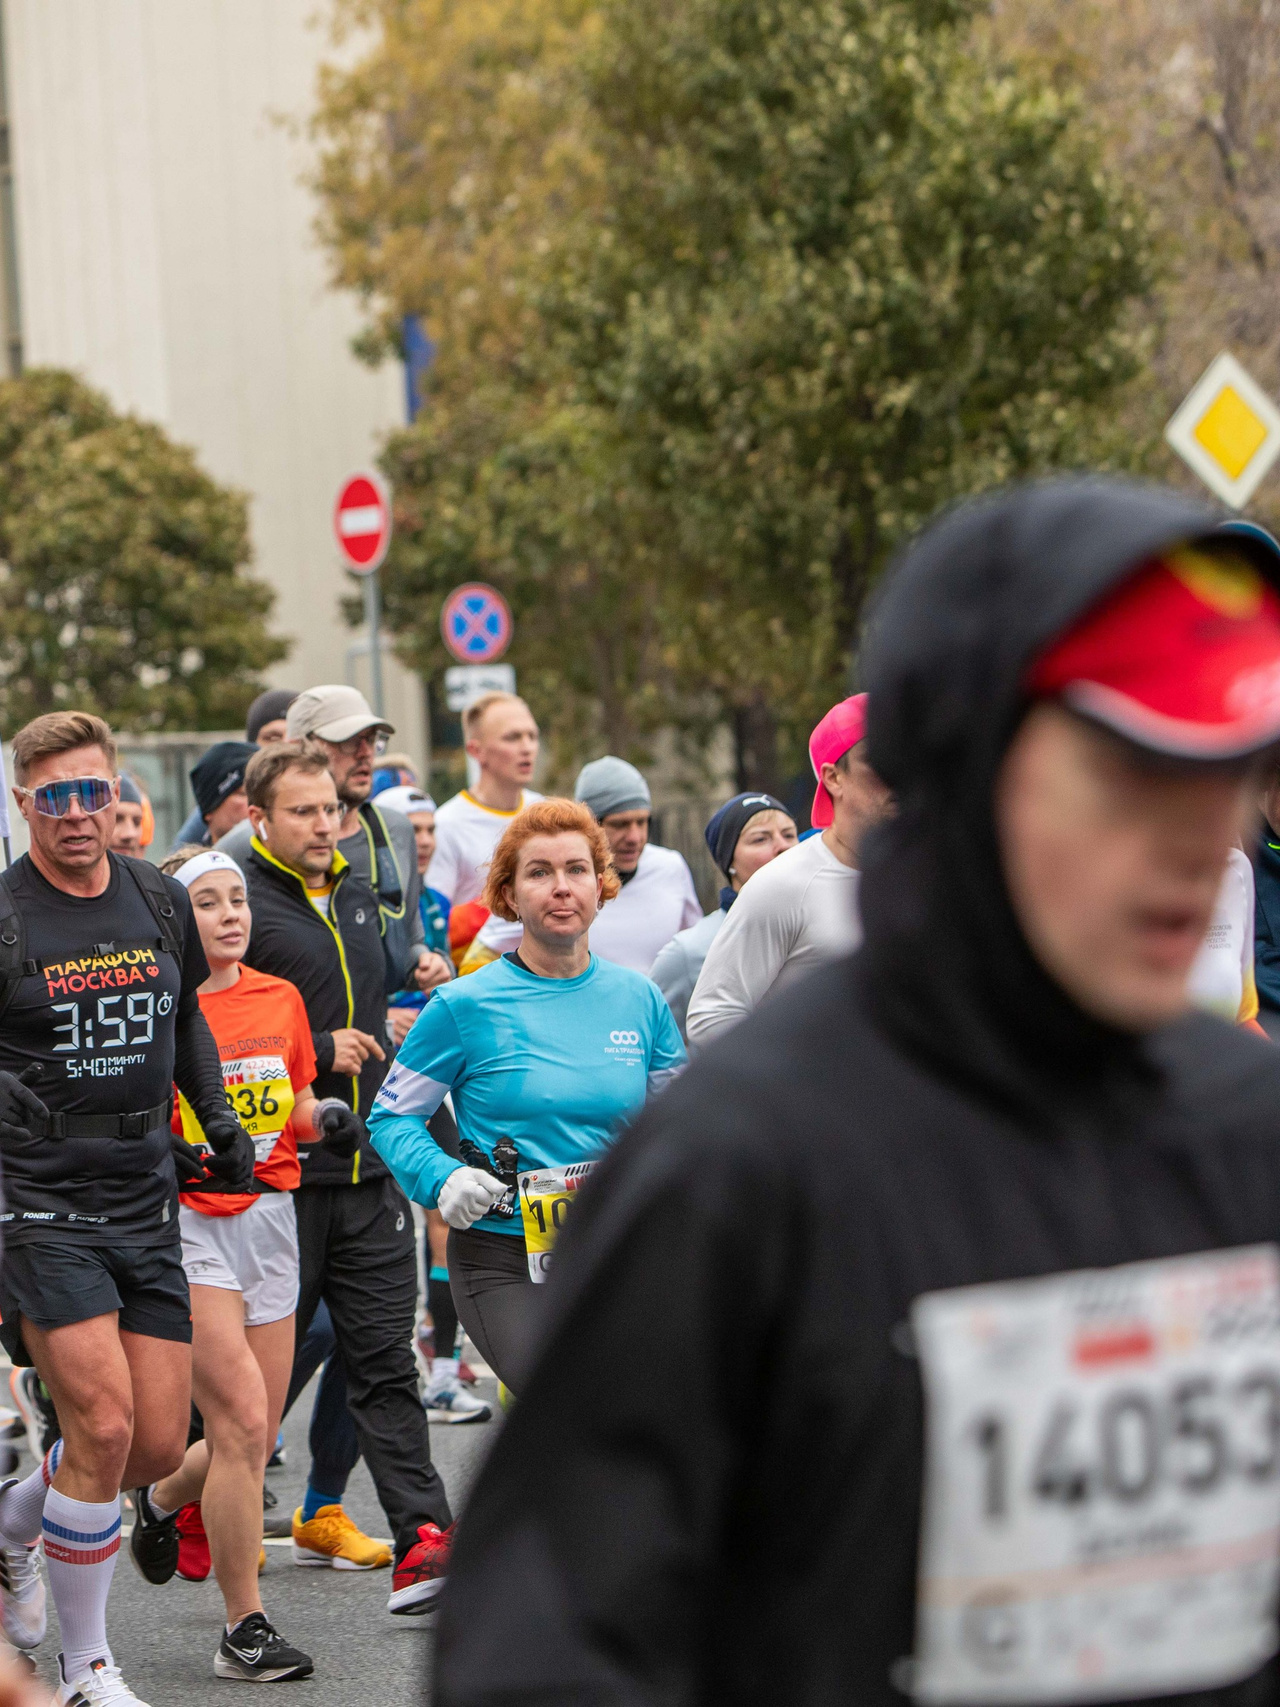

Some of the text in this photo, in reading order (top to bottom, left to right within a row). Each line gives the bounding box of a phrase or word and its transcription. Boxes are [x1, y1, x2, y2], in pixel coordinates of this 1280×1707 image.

[43, 949, 156, 979] МАРАФОН
[46, 966, 146, 998] МОСКВА
[51, 992, 155, 1051] 3:59
[66, 1058, 108, 1079] 5:40
[108, 1066, 124, 1076] КМ
[22, 1212, 56, 1220] FONBET
[972, 1363, 1280, 1529] 14053
